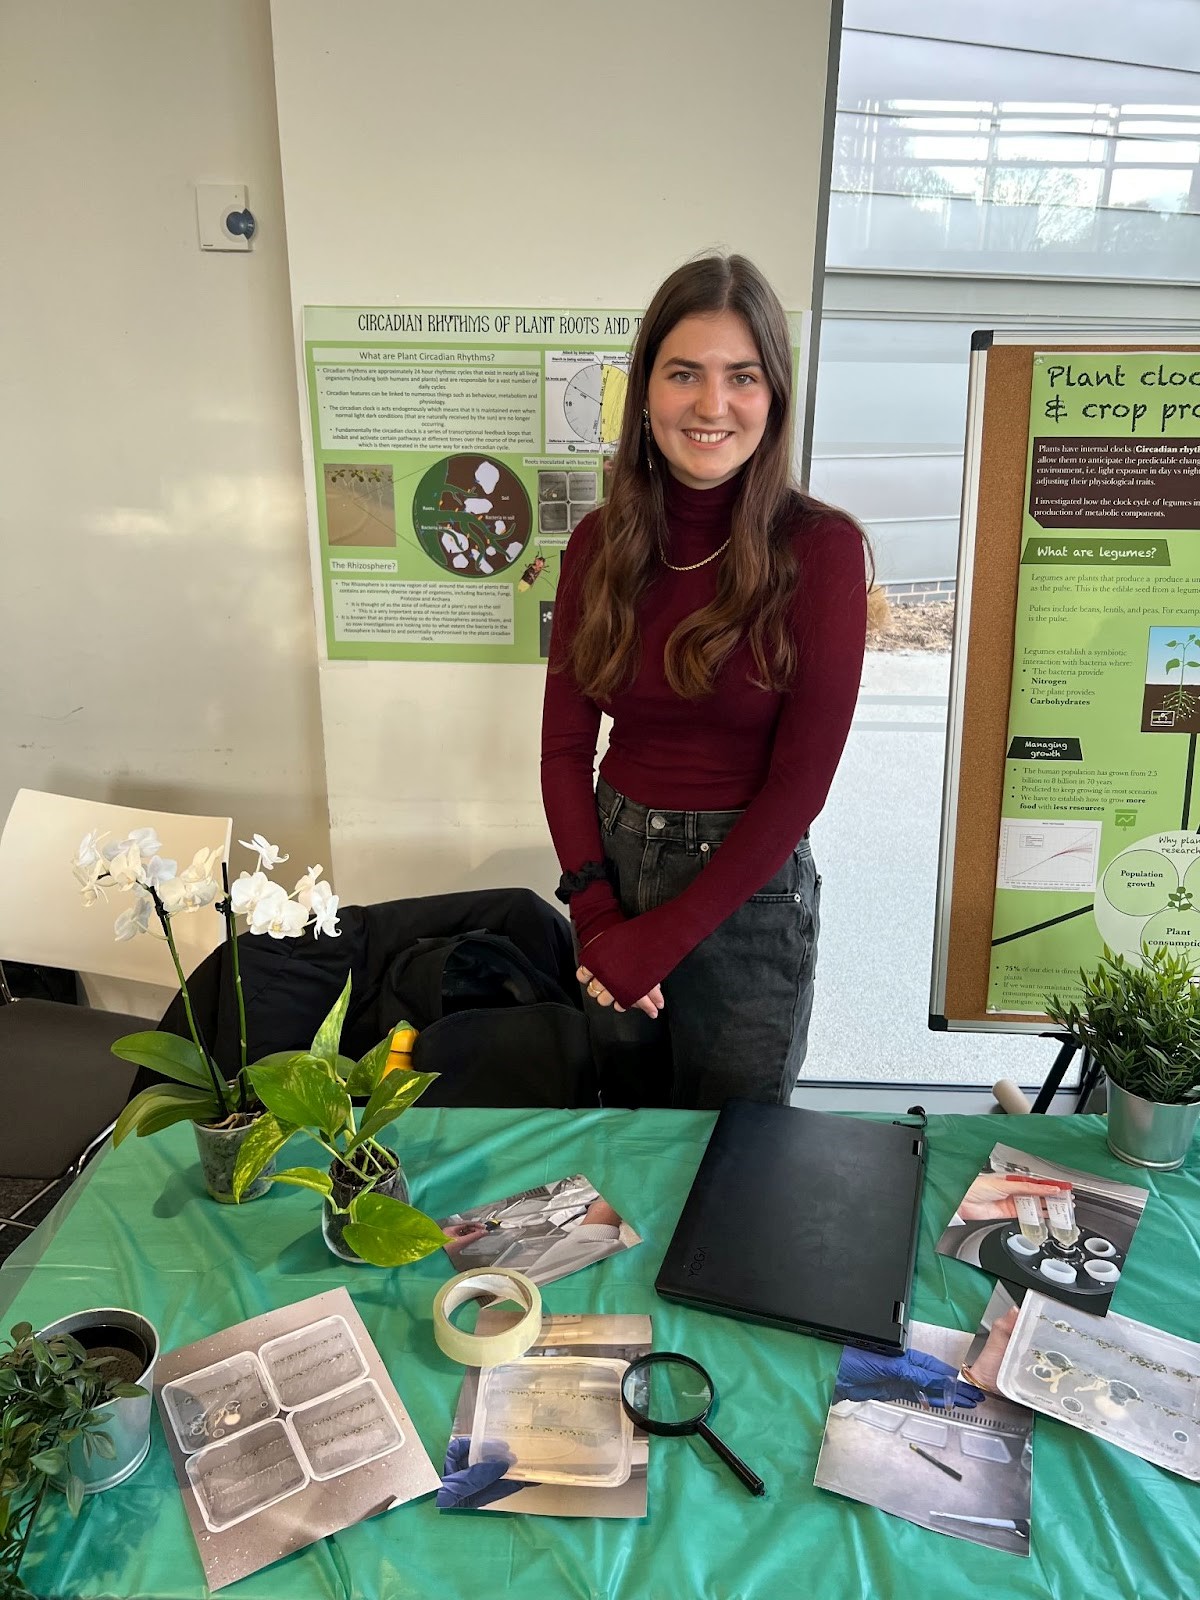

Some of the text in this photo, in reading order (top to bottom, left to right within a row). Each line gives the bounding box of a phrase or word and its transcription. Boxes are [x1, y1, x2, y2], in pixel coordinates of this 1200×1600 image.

[358, 314, 423, 332] CIRCADIAN
[428, 315, 490, 333] RHYTHMS
[494, 316, 510, 333] OF
[515, 316, 555, 334] PLANT
[559, 317, 599, 335] ROOTS
[604, 318, 630, 336] AND
[359, 352, 381, 361] What
[397, 352, 417, 362] Plant
[419, 353, 456, 362] Circadian
[457, 353, 496, 363] Rhythms?
[1047, 365, 1125, 387] Plant
[1045, 394, 1067, 423] &
[1082, 403, 1147, 432] crop
[1039, 445, 1060, 453] Plants
[1062, 445, 1079, 453] have
[1080, 445, 1108, 453] internal
[1110, 445, 1132, 453] clocks
[1133, 445, 1177, 454] (Circadian
[1088, 457, 1123, 465] anticipate
[1137, 457, 1178, 466] predictable
[1037, 467, 1084, 475] environment,
[1098, 467, 1114, 475] light
[1115, 468, 1148, 476] exposure
[1158, 467, 1171, 476] day
[1036, 478, 1069, 486] adjusting
[1089, 478, 1134, 487] physiological
[1136, 478, 1156, 486] traits.
[1040, 498, 1082, 506] investigated
[1113, 498, 1132, 506] clock
[1133, 498, 1150, 507] cycle
[1152, 498, 1162, 506] of
[1163, 498, 1192, 508] legumes
[1034, 508, 1166, 519] production of metabolic components.
[1037, 546, 1157, 561] What are legumes?
[332, 561, 396, 570] The Rhizosphere?
[1031, 573, 1063, 583] Legumes
[1077, 575, 1099, 583] plants
[1115, 575, 1144, 584] produce
[1154, 575, 1184, 584] produce
[1029, 604, 1051, 612] Pulses
[1080, 605, 1102, 614] beans,
[1103, 606, 1126, 614] lentils,
[1127, 606, 1141, 614] and
[1142, 608, 1159, 616] peas.
[1162, 606, 1174, 614] For
[1024, 648, 1055, 656] Legumes
[1093, 649, 1127, 657] symbiotic
[1022, 658, 1061, 666] interaction
[1078, 669, 1104, 677] provide
[1031, 678, 1067, 686] Nitrogen
[1030, 698, 1090, 707] Carbohydrates
[1025, 741, 1068, 751] Managing
[1030, 751, 1061, 759] growth
[1061, 787, 1075, 795] keep
[1159, 836, 1176, 847] Why
[1120, 870, 1163, 878] Population
[1166, 928, 1191, 936] Plant
[688, 1246, 710, 1277] YOGA
